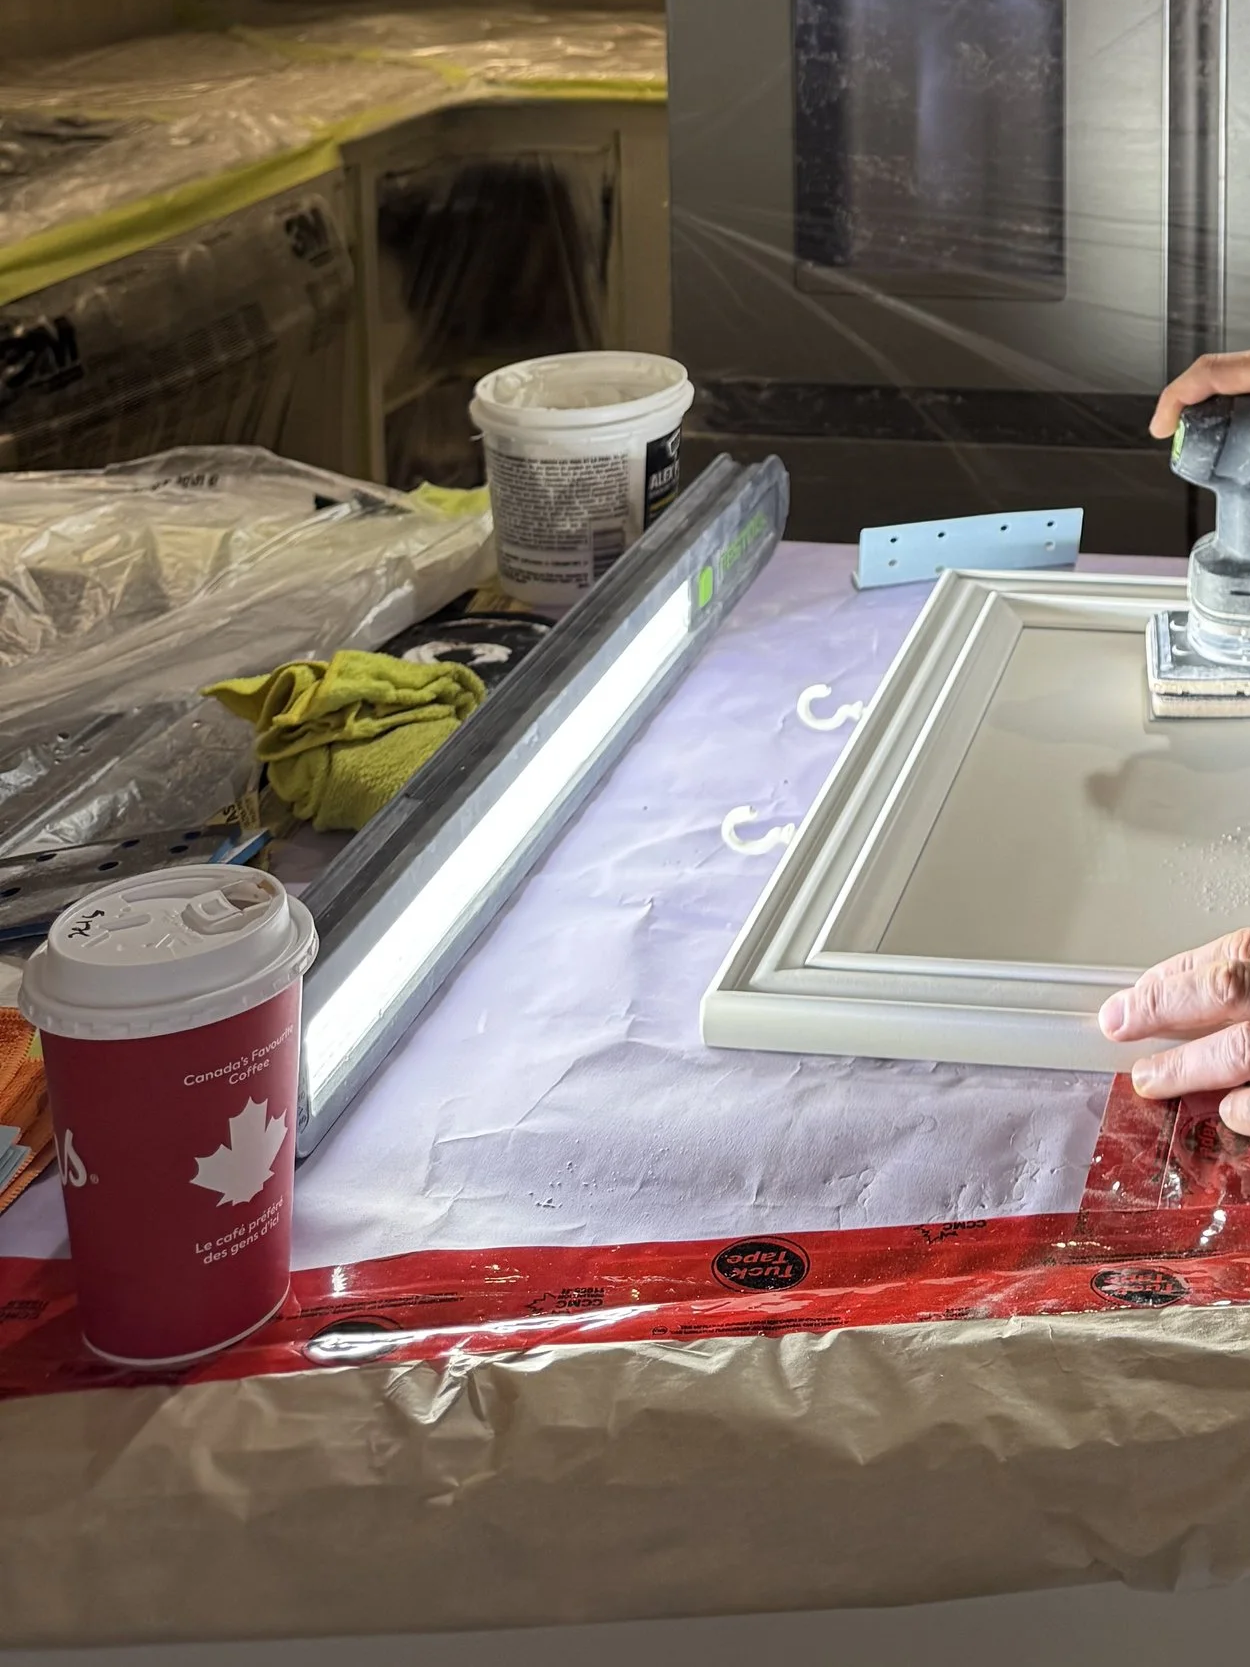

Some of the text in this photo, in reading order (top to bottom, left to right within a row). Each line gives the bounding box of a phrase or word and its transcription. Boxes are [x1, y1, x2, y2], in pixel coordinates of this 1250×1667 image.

[183, 1024, 294, 1086] Canada's Favourite
[228, 1058, 270, 1085] Coffee
[195, 1194, 284, 1254] Le café préféré
[203, 1212, 280, 1265] des gens d'ici
[726, 1250, 788, 1265] Tape
[732, 1264, 793, 1280] Tuck
[556, 1298, 603, 1309] CCMC
